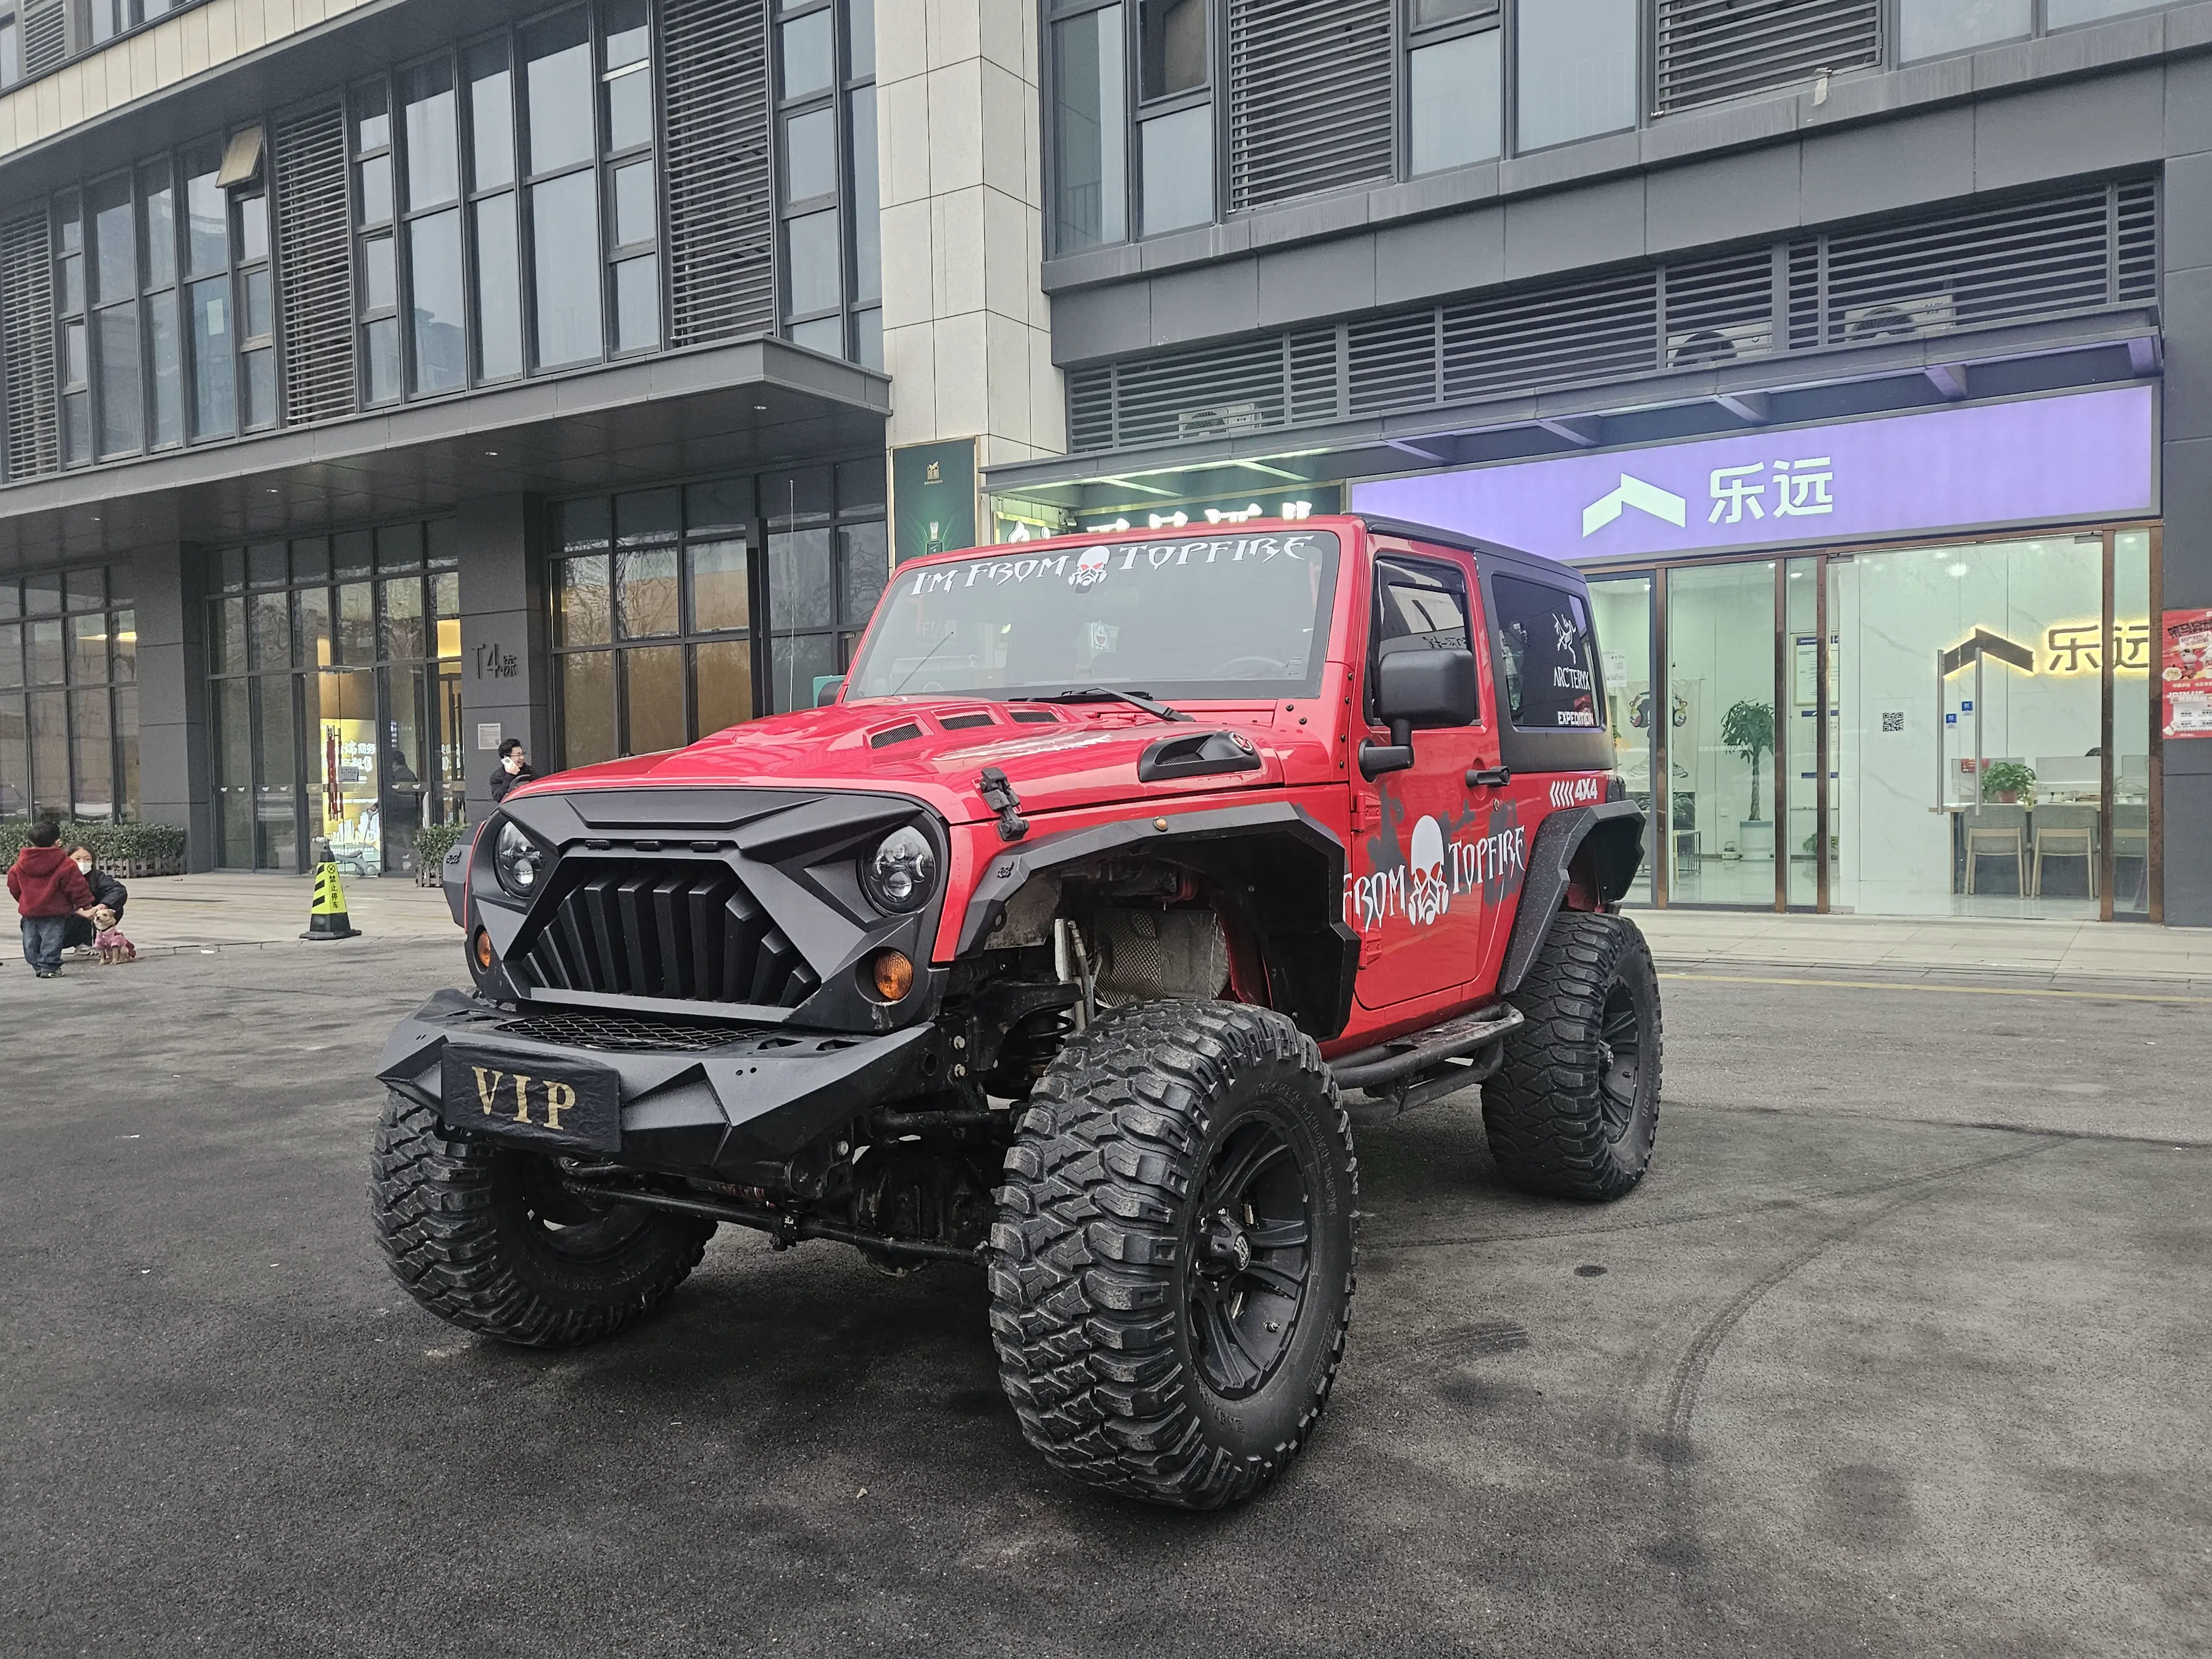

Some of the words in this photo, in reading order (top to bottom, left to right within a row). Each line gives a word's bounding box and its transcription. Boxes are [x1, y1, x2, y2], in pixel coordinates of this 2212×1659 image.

[1708, 456, 1833, 524] 乐远
[911, 570, 958, 595] I'M
[964, 555, 1070, 586] FROM
[1119, 535, 1315, 571] TOPFIRE
[2049, 624, 2149, 671] 乐远
[329, 875, 339, 909] 禁止停车
[1343, 864, 1406, 933] FROM
[1448, 825, 1526, 894] TOPFIRE
[471, 1066, 576, 1130] VIP
